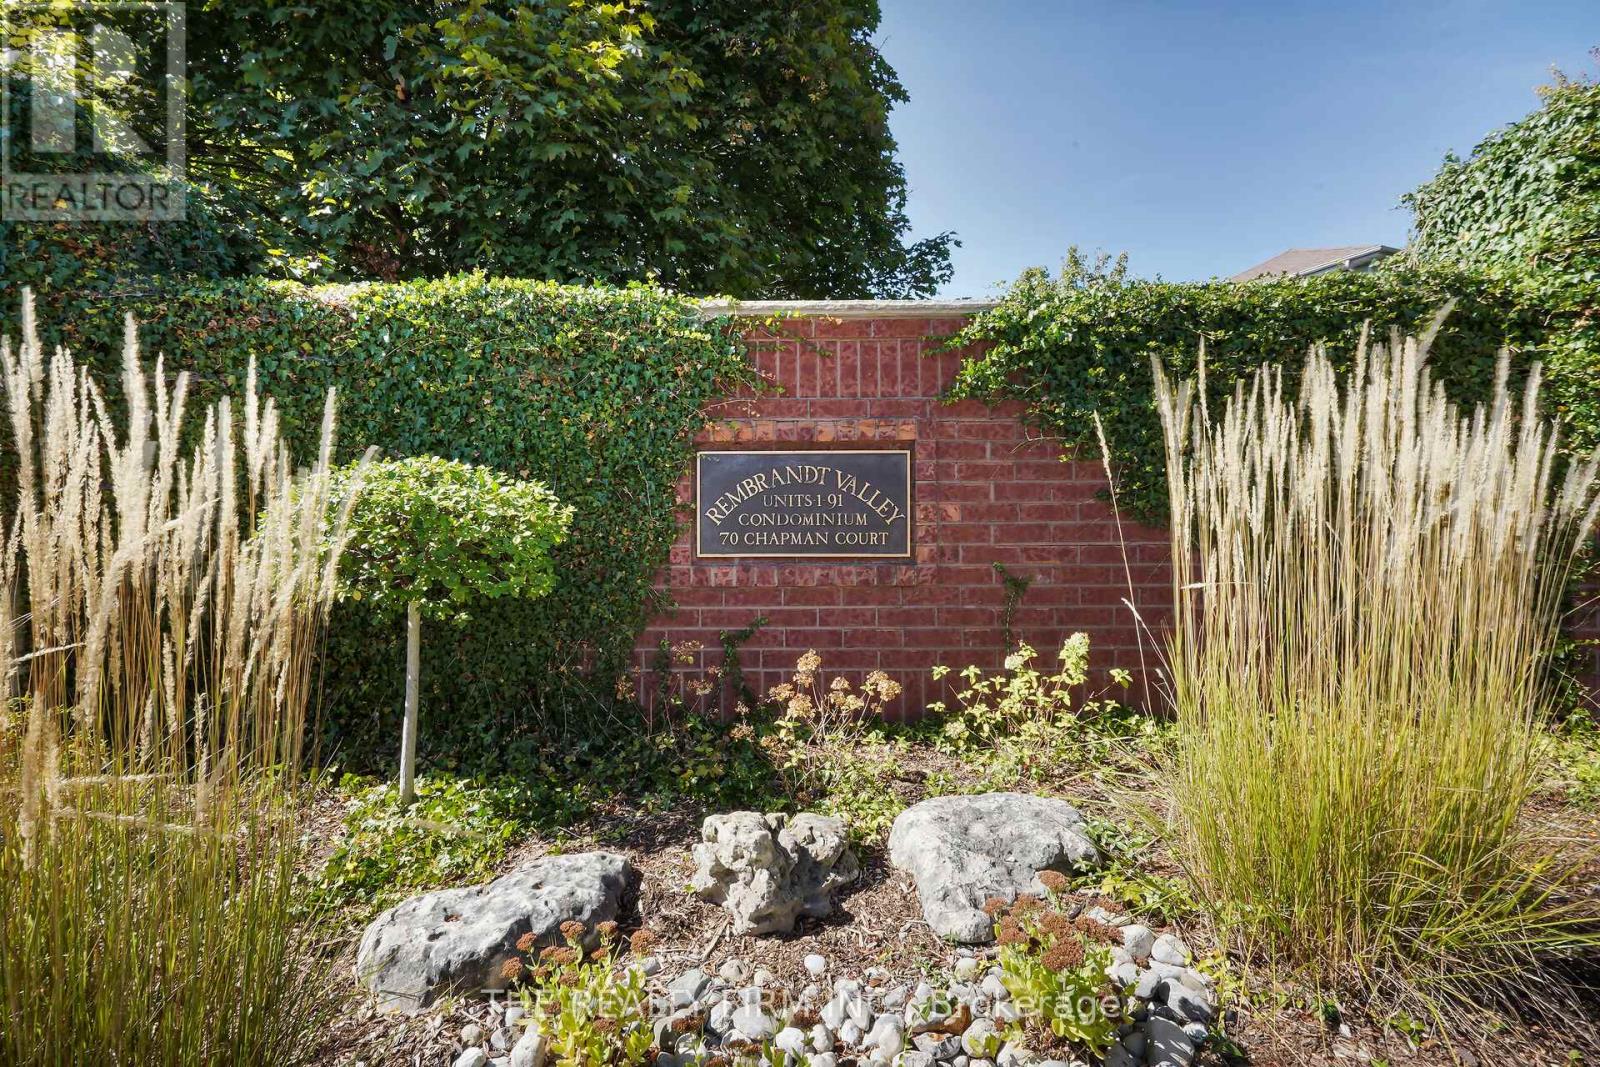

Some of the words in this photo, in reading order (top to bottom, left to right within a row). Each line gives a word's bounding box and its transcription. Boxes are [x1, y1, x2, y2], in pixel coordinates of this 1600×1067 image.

[704, 465, 831, 527] REMBRANDT
[834, 468, 905, 525] VALLEY
[763, 494, 813, 507] UNITS
[738, 512, 868, 527] CONDOMINIUM
[719, 532, 739, 545] 70
[744, 532, 828, 545] CHAPMAN
[835, 532, 889, 545] COURT
